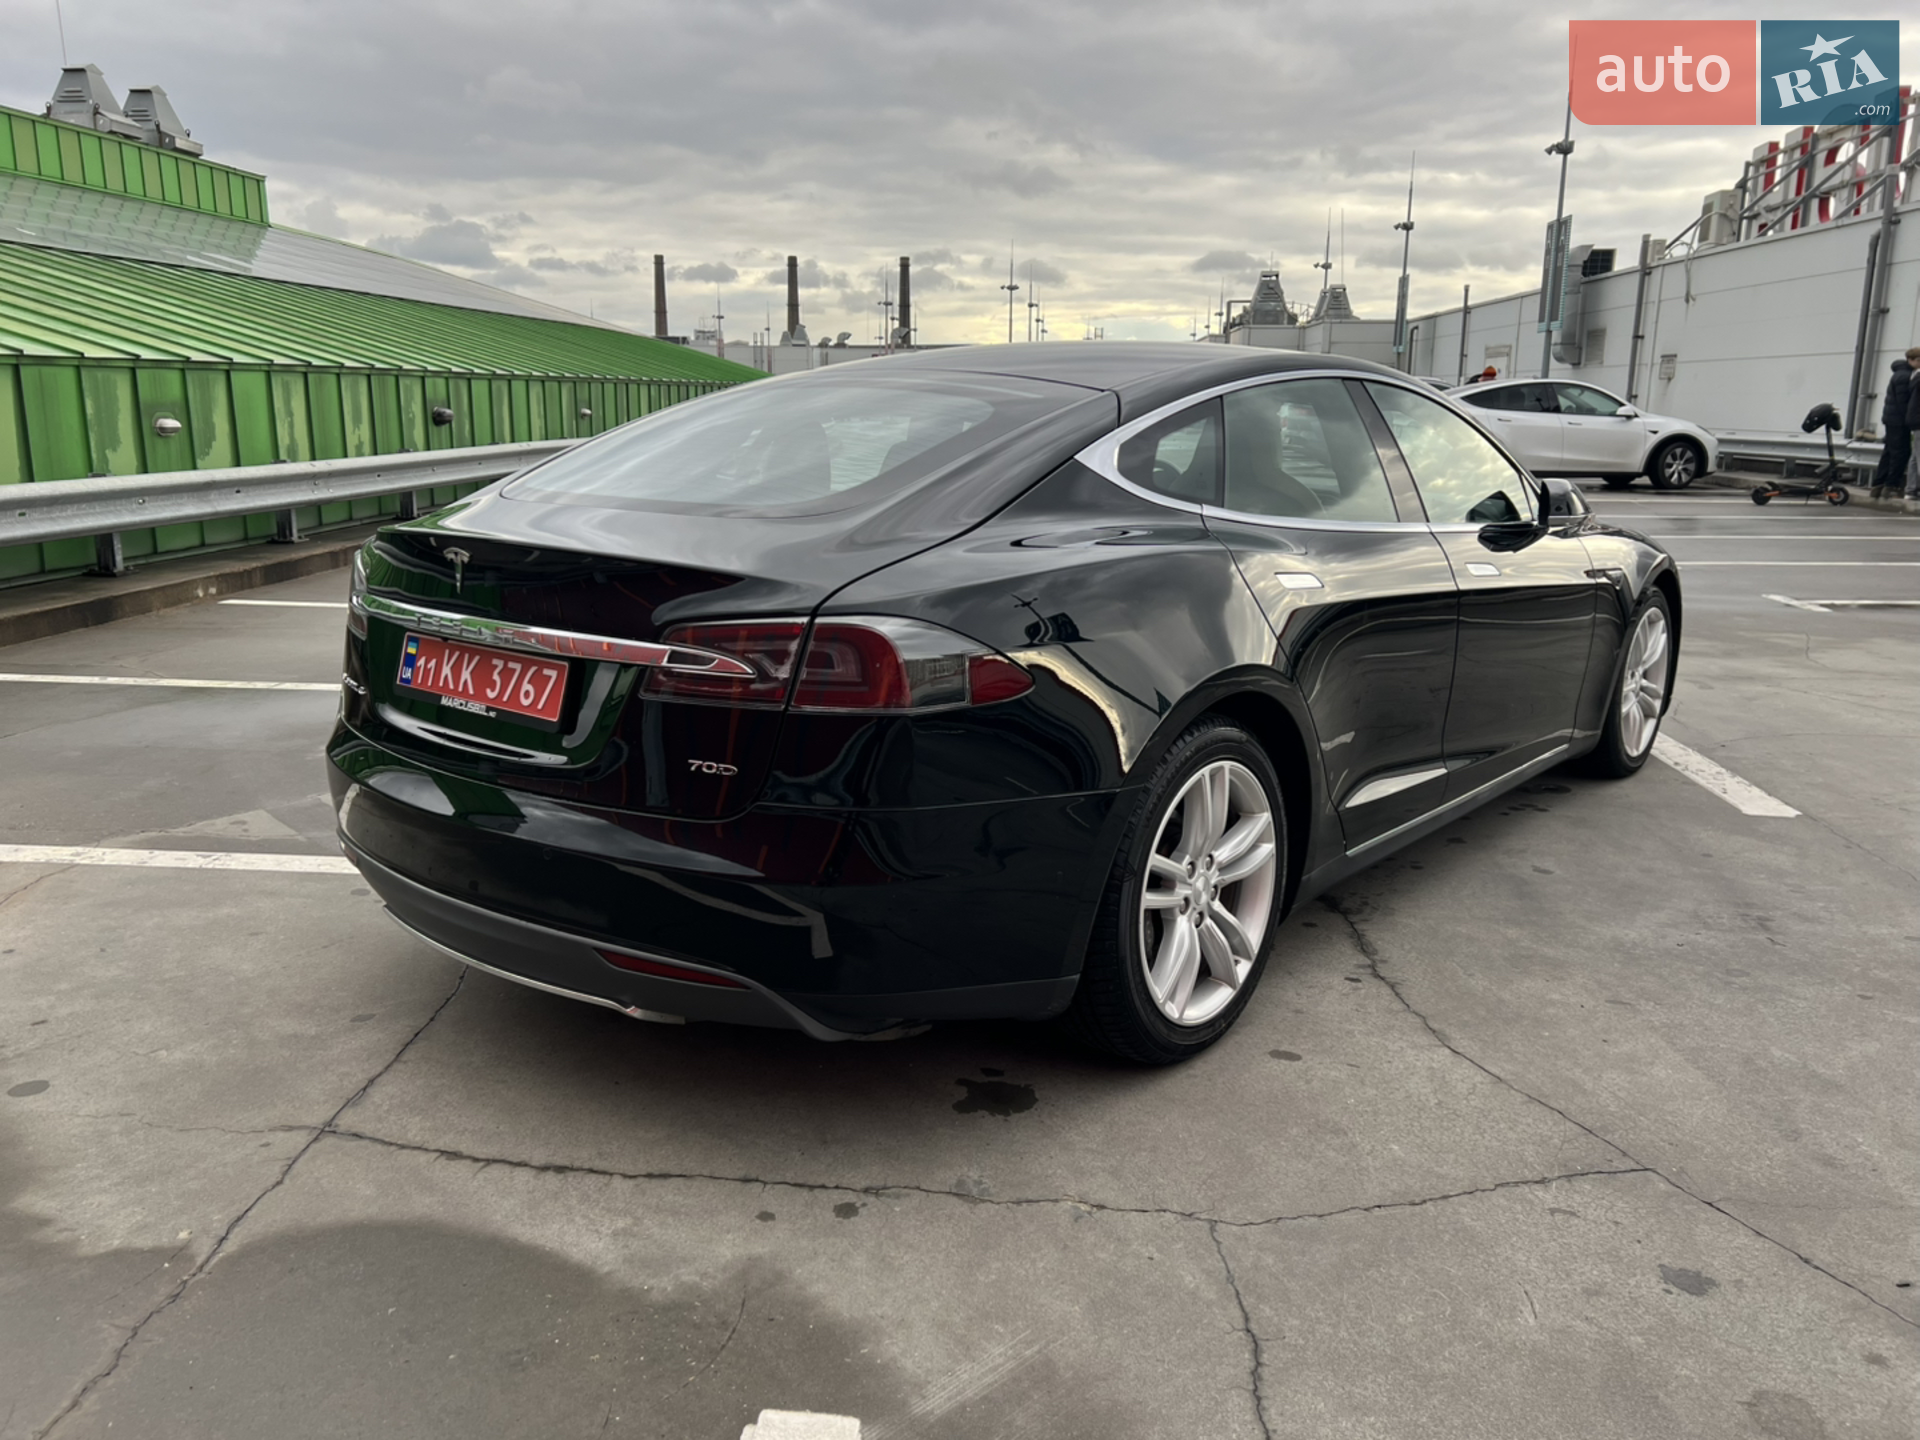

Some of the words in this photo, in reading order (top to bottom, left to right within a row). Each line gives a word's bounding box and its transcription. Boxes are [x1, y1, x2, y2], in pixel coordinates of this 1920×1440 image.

[402, 666, 412, 680] UA
[485, 658, 559, 710] 3767
[687, 759, 738, 776] 70D
